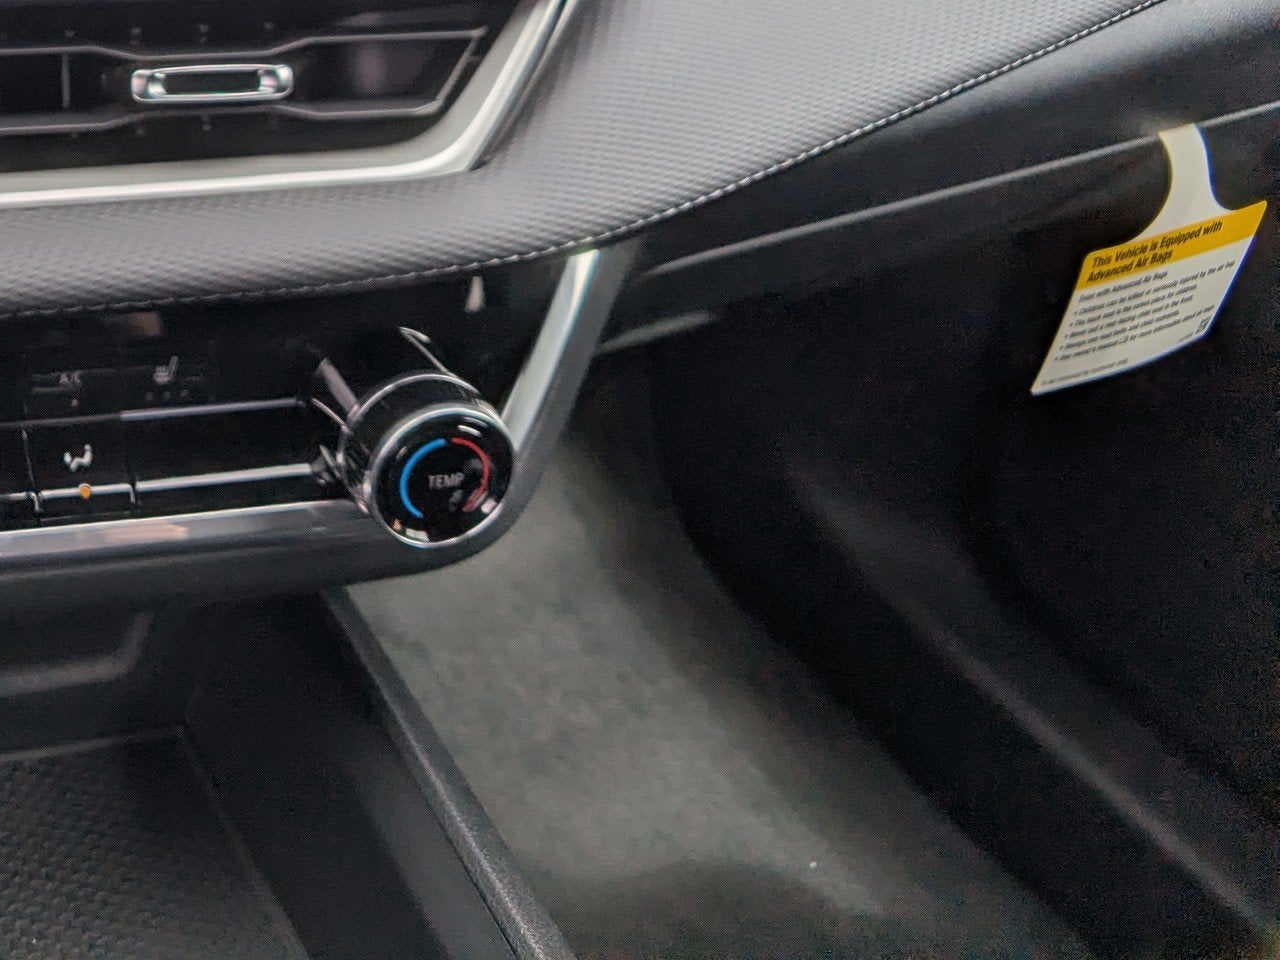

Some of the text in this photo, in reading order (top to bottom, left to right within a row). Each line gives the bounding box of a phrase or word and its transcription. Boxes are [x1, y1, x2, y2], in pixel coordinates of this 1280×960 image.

[1092, 221, 1223, 272] This Vehicle is Equipped with
[1086, 250, 1174, 283] Advanced Air Bags
[428, 471, 464, 489] TEMP
